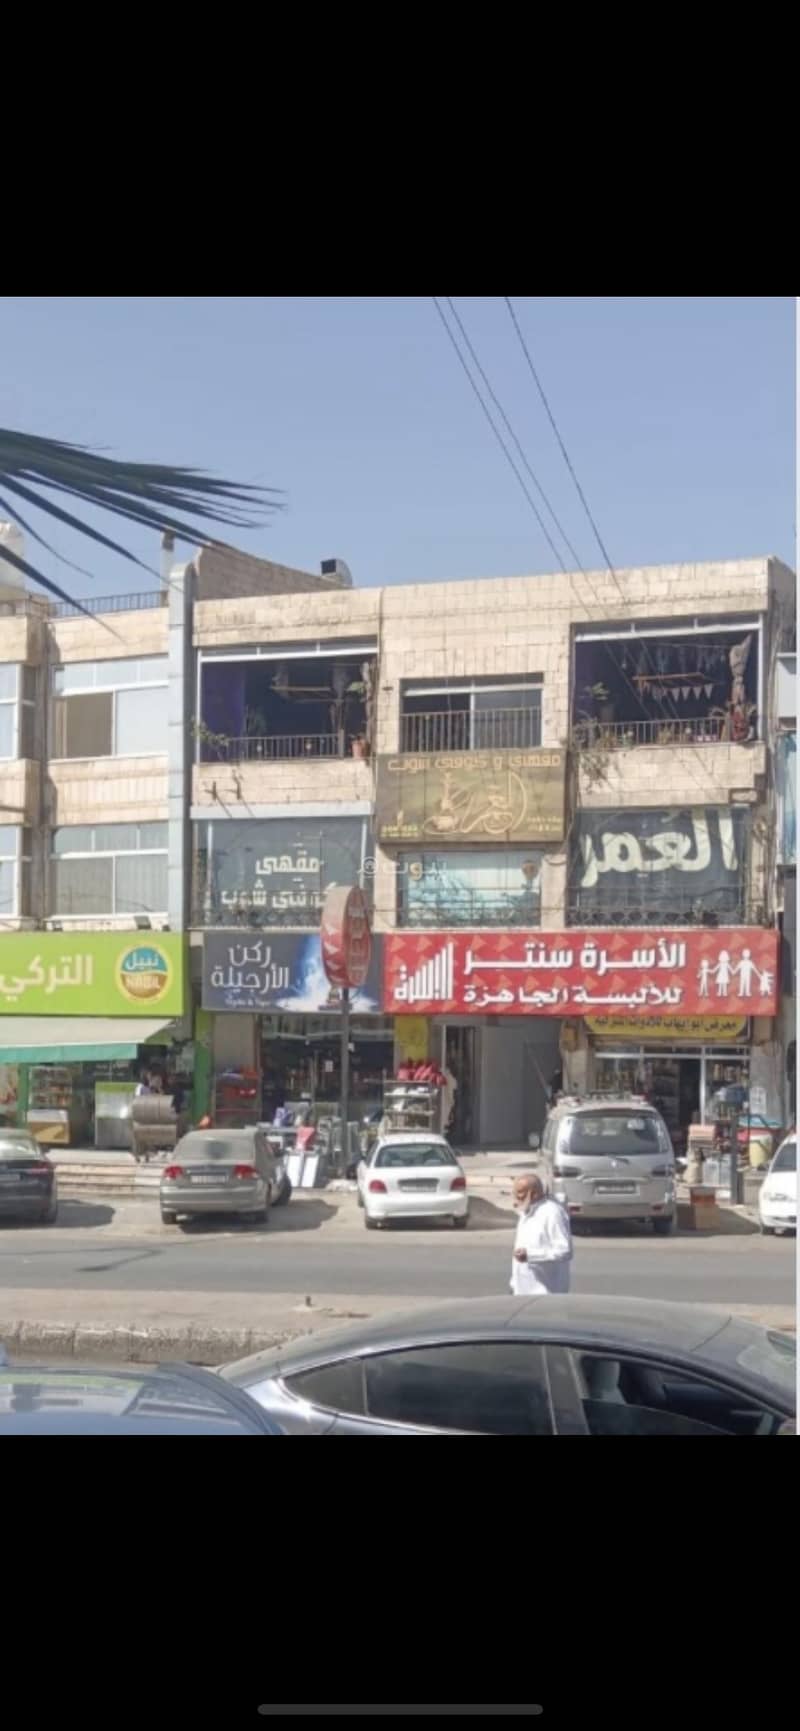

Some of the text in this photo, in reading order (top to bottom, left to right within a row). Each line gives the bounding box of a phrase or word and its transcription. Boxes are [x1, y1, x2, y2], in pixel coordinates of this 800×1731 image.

[125, 951, 159, 970] نبيل
[228, 940, 271, 968] ركن
[464, 937, 686, 976] الأسرة سنتر
[0, 953, 93, 1001] التركي
[210, 962, 290, 994] الأرجيلة
[463, 984, 569, 1007] الجاهزة
